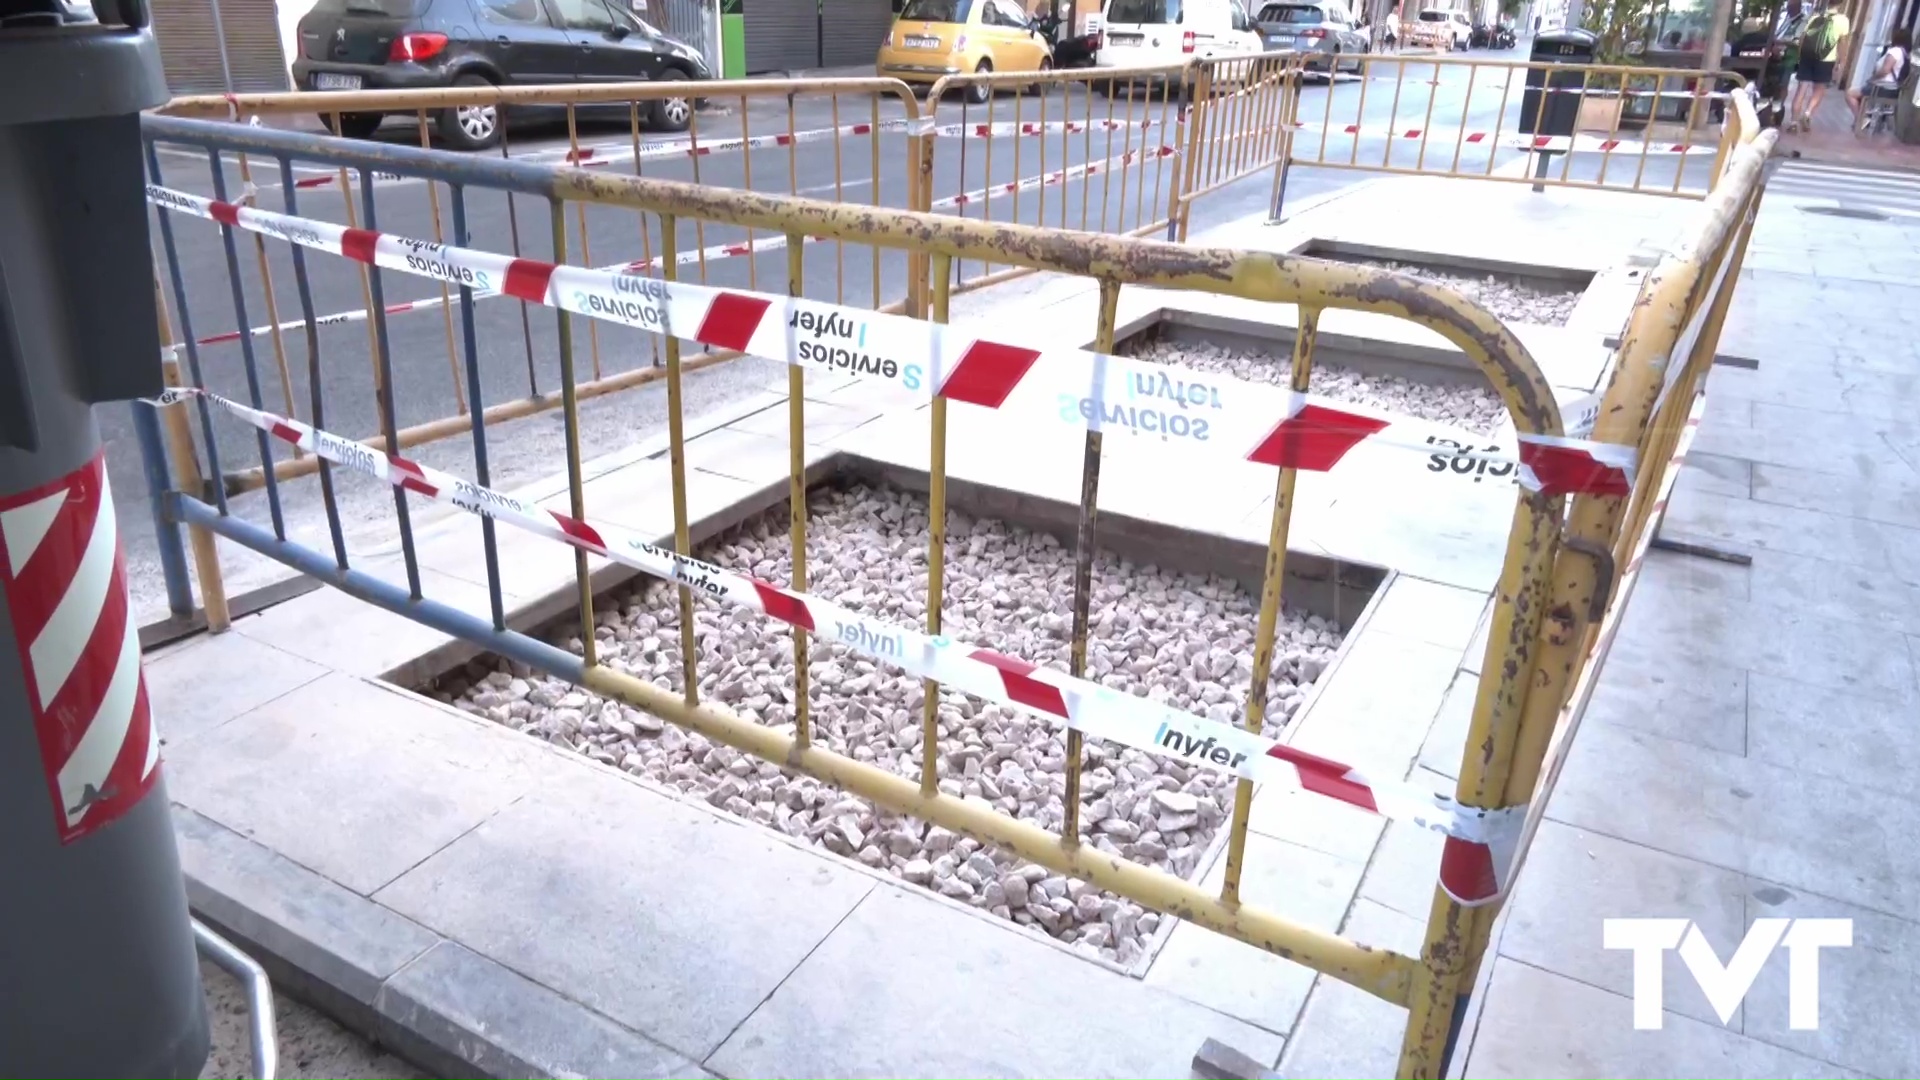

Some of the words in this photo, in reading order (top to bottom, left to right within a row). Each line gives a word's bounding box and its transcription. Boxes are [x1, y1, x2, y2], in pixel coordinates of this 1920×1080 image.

[406, 254, 490, 289] Servicios
[789, 310, 866, 347] Inyfer
[799, 340, 923, 390] Servicios
[1154, 721, 1248, 770] Inyfer
